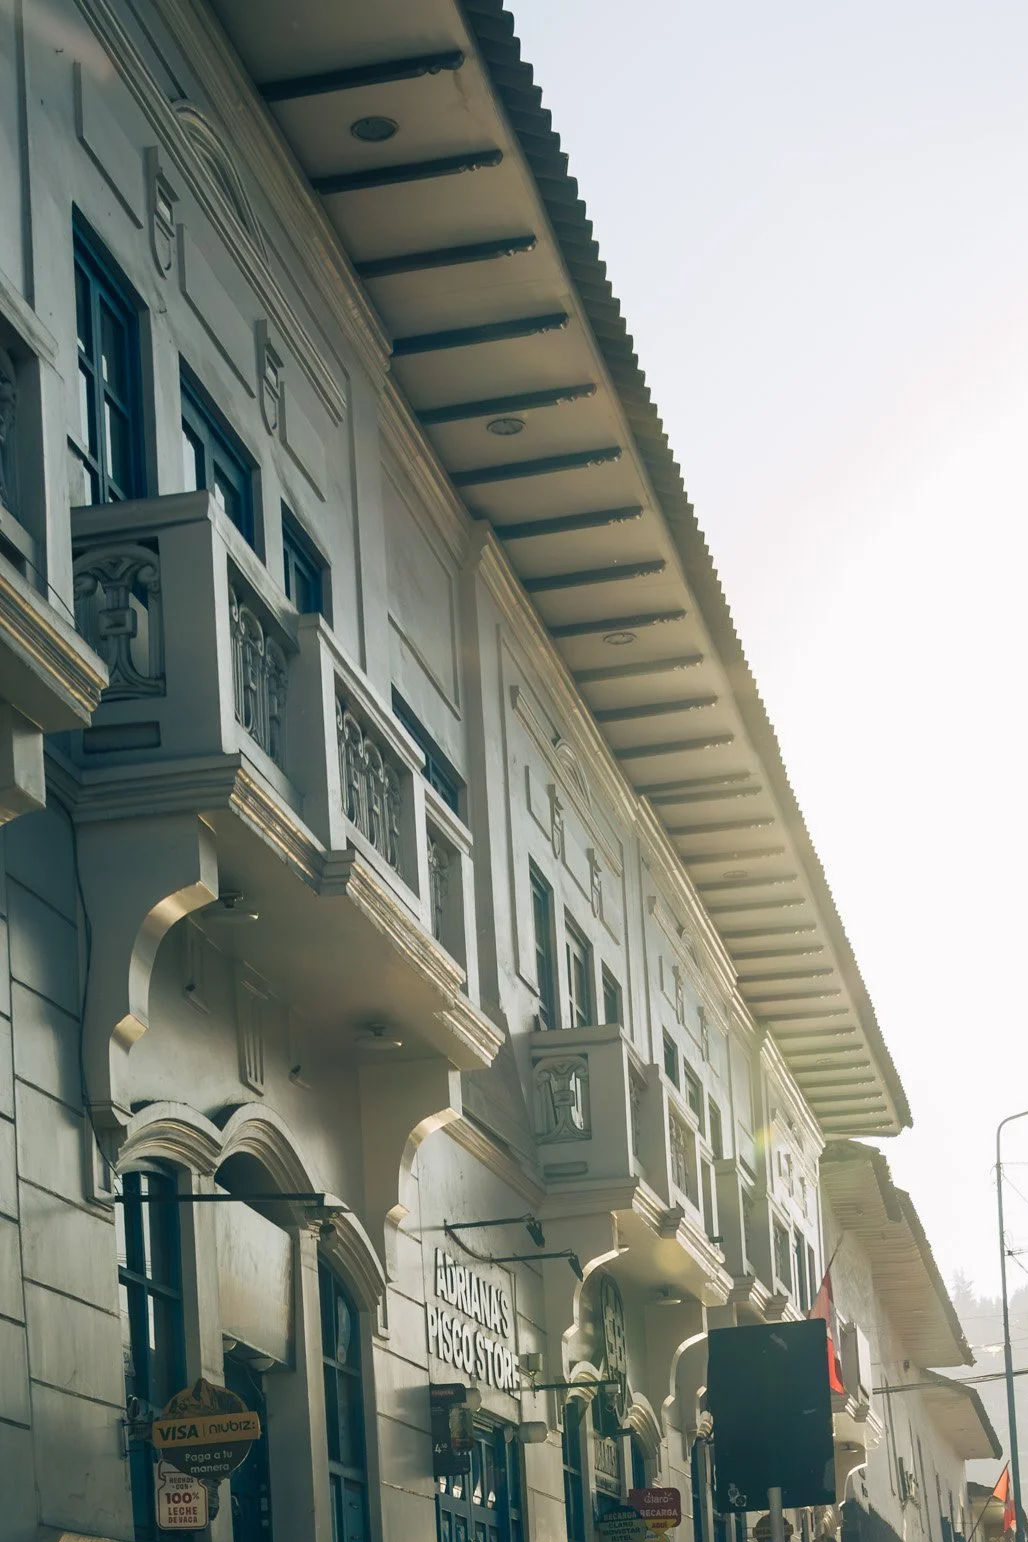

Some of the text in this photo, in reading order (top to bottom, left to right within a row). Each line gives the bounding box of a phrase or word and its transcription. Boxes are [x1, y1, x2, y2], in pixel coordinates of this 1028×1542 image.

[435, 1247, 509, 1339] ADRIANA'S
[425, 1302, 521, 1400] PISCO STORE
[157, 1424, 199, 1441] VISA
[223, 1449, 233, 1459] tu
[190, 1463, 230, 1474] manera
[165, 1492, 200, 1505] 100%
[644, 1495, 669, 1504] Claro
[168, 1507, 198, 1516] LECHE
[640, 1508, 678, 1517] RECARGA
